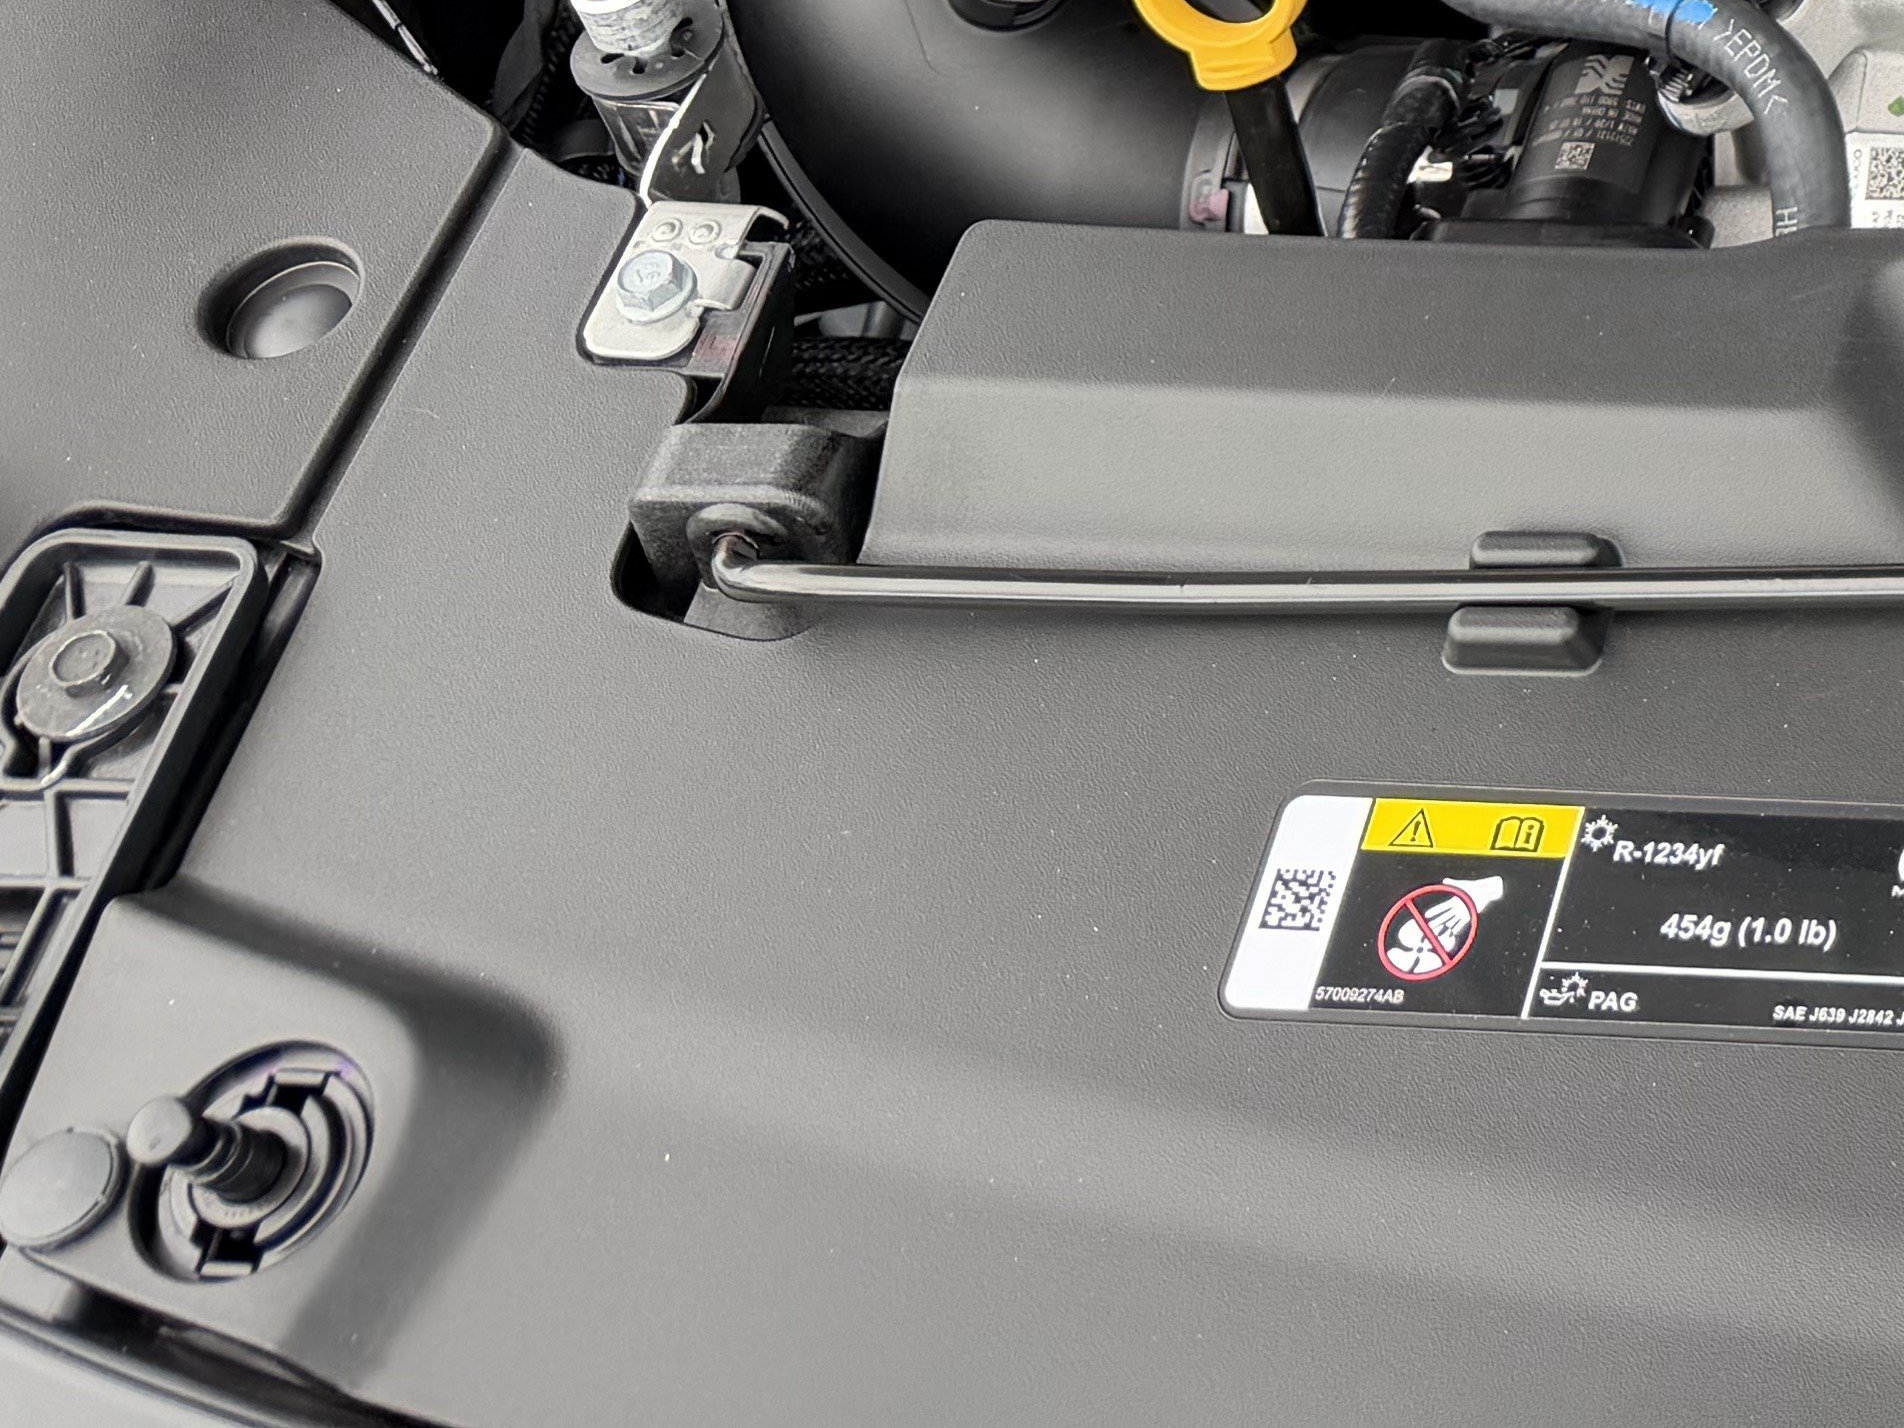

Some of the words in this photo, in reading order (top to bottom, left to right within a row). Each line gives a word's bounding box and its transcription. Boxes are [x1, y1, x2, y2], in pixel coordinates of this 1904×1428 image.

[1713, 18, 1789, 115] >EPDM<
[1612, 839, 1725, 871] R-1234yf
[1660, 916, 1730, 947] 454g
[1736, 918, 1792, 949] (1.0
[1797, 919, 1838, 951] lb)
[1314, 984, 1405, 1006] 57009274AB
[1588, 990, 1639, 1014] PAG
[1773, 1004, 1808, 1022] SAE
[1810, 1006, 1845, 1024] J639
